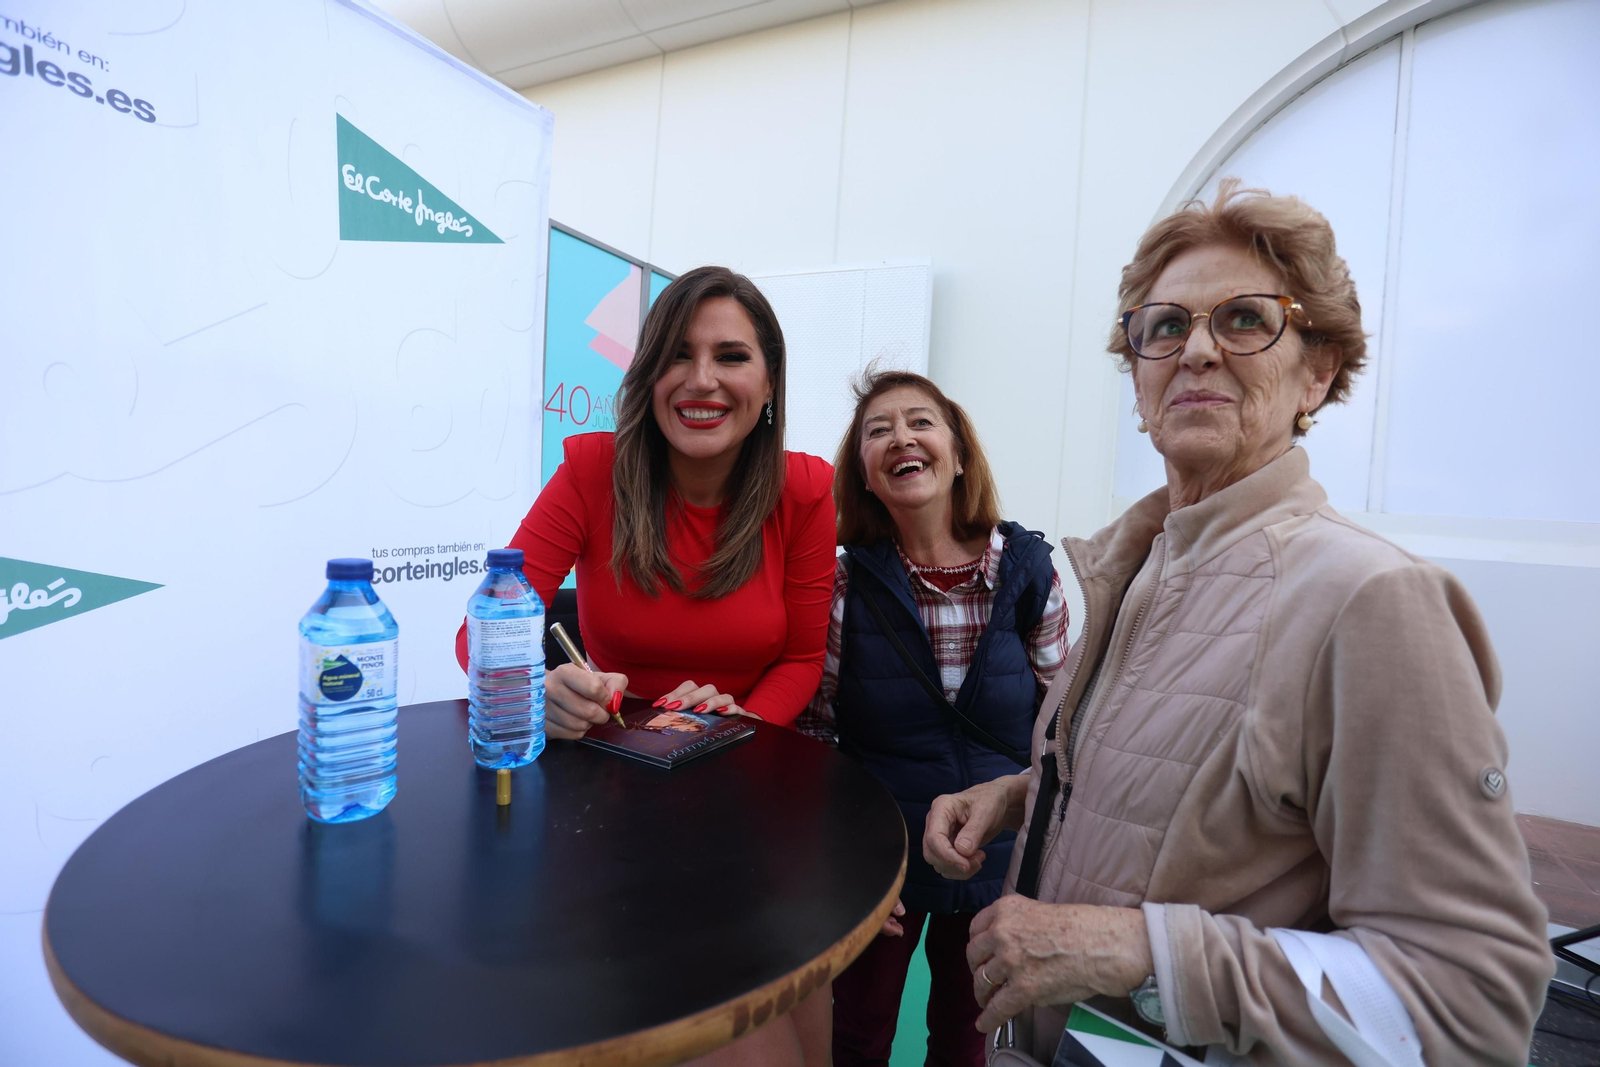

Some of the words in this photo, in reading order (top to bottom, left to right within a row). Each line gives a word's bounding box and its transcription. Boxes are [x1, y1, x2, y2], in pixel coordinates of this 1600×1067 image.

[77, 49, 109, 72] en:
[341, 163, 365, 194] El
[365, 175, 413, 213] Corte
[414, 188, 473, 237] Inglés
[544, 382, 591, 426] 40
[592, 394, 615, 414] AÑ
[591, 415, 617, 430] JUN
[371, 547, 389, 558] tus
[391, 545, 435, 558] compras
[437, 541, 472, 554] también
[473, 542, 486, 551] en:
[366, 689, 375, 698] 50
